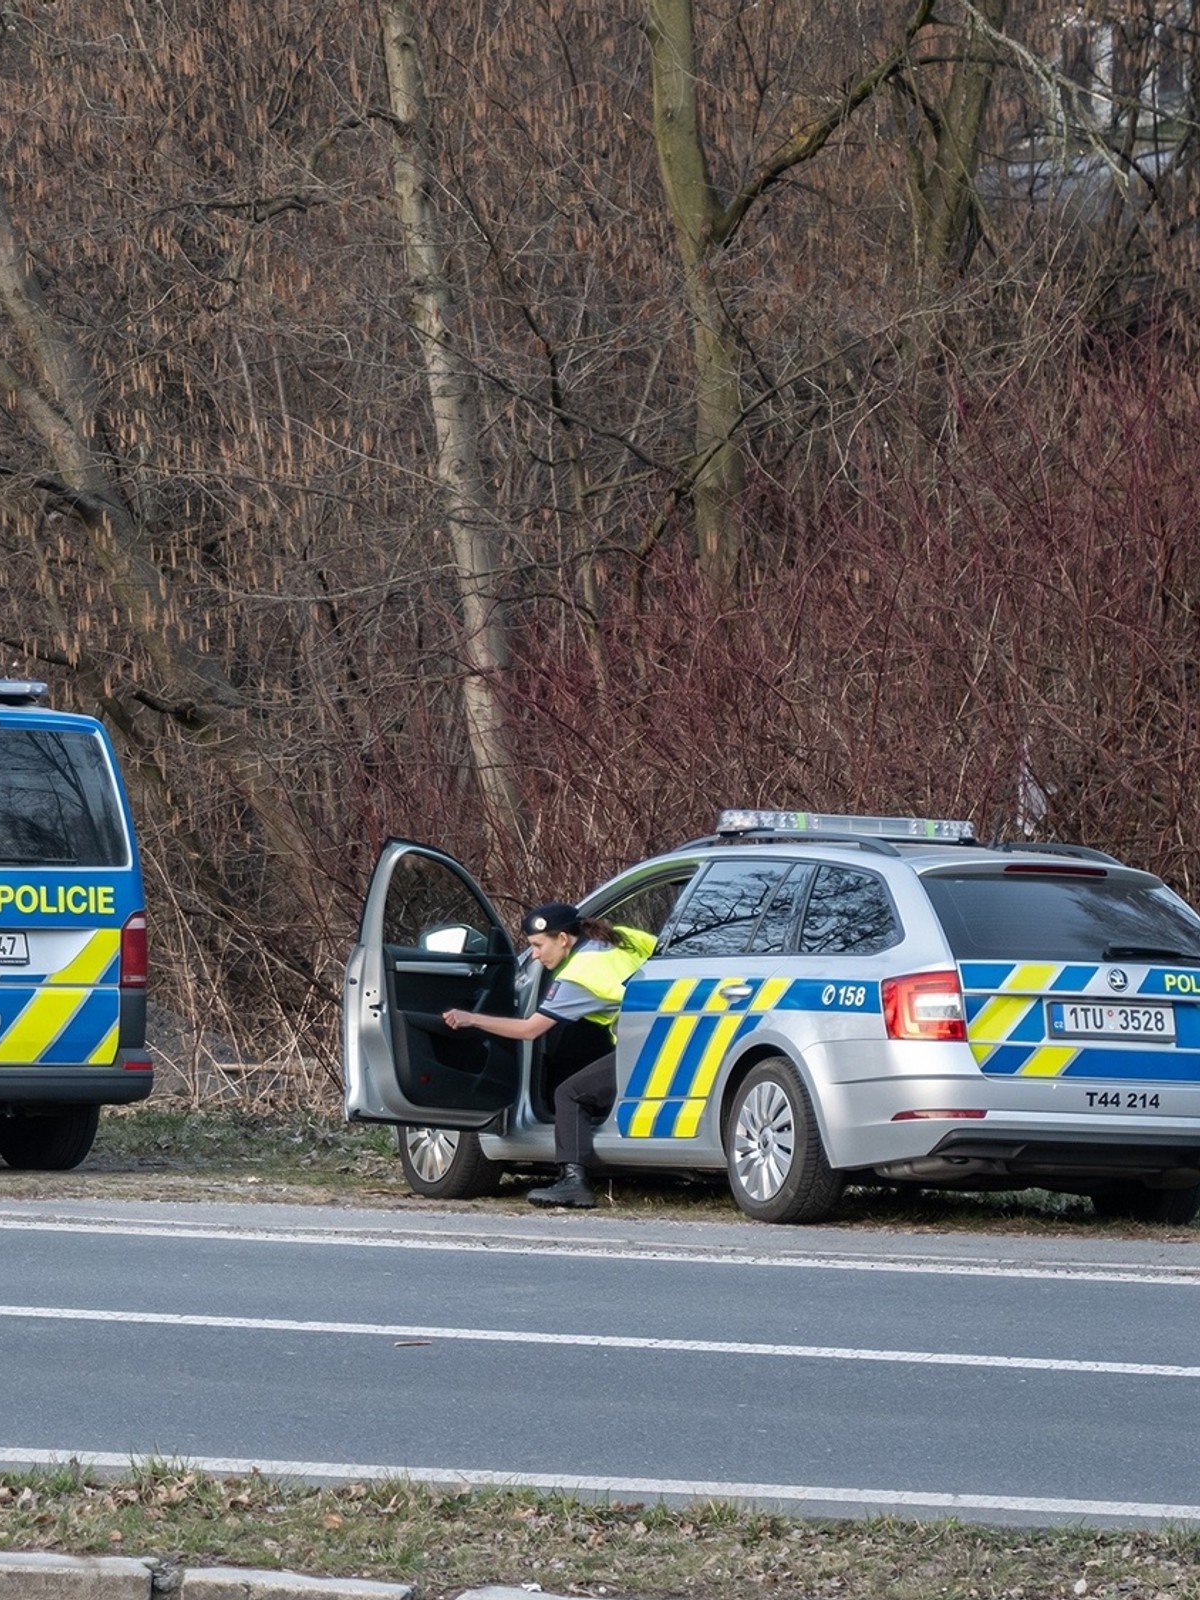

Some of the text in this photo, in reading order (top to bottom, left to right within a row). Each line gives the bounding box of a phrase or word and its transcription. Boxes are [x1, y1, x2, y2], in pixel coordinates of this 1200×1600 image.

[1164, 974, 1200, 993] POL
[838, 986, 866, 1006] 158
[1070, 1007, 1165, 1032] 1TU 3528
[1086, 1092, 1160, 1109] T44 214
